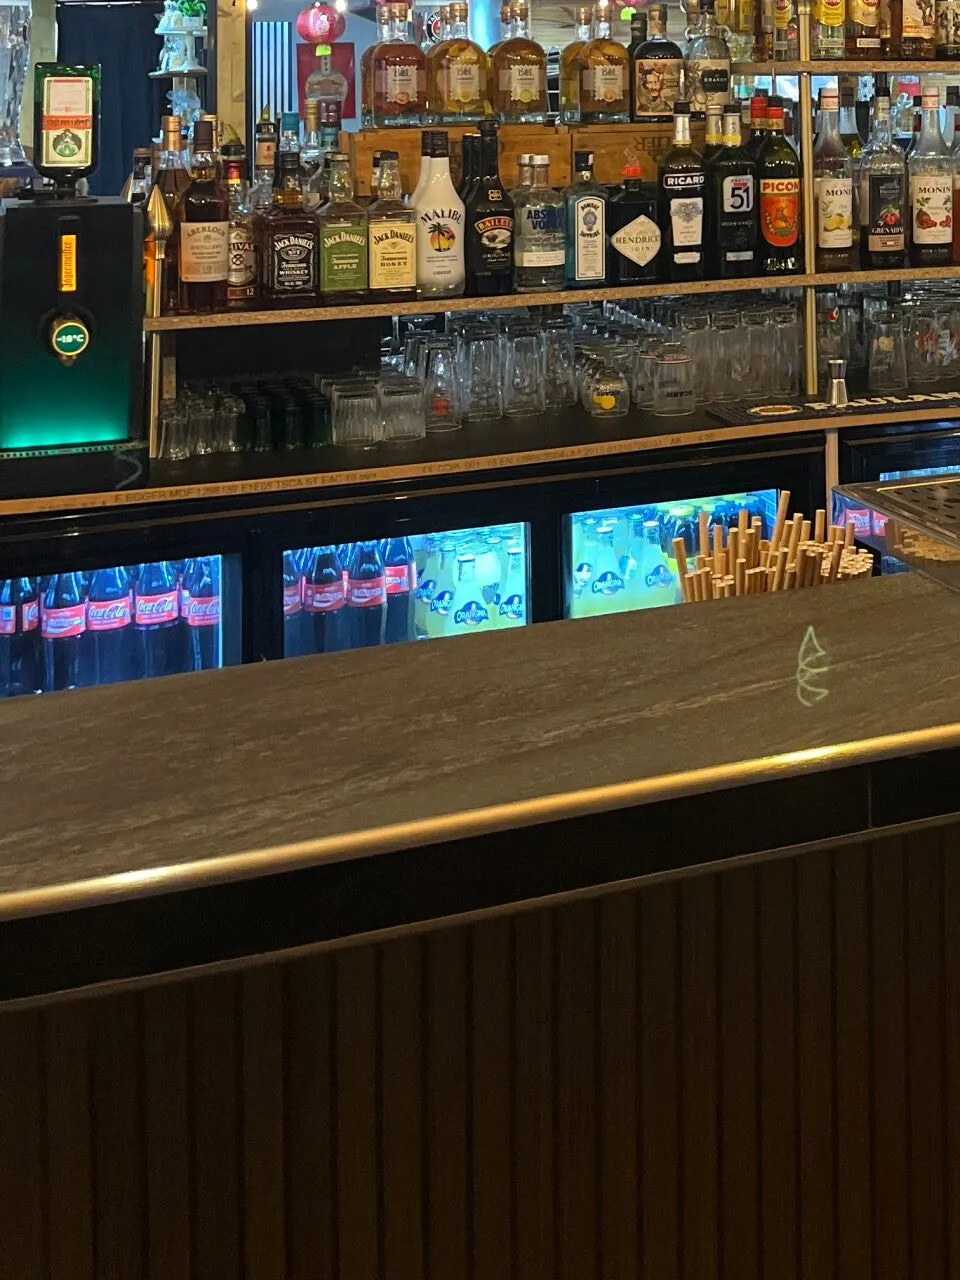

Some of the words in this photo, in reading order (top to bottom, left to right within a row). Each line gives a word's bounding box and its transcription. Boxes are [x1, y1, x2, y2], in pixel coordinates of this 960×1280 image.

[667, 175, 705, 186] RICARD
[762, 181, 800, 192] PICON
[730, 185, 750, 209] 51
[825, 189, 852, 197] MONI
[420, 207, 464, 226] MALIBU
[274, 238, 289, 251] JACK
[324, 235, 340, 248] JACK
[373, 232, 389, 246] JACK
[246, 287, 255, 296] 12
